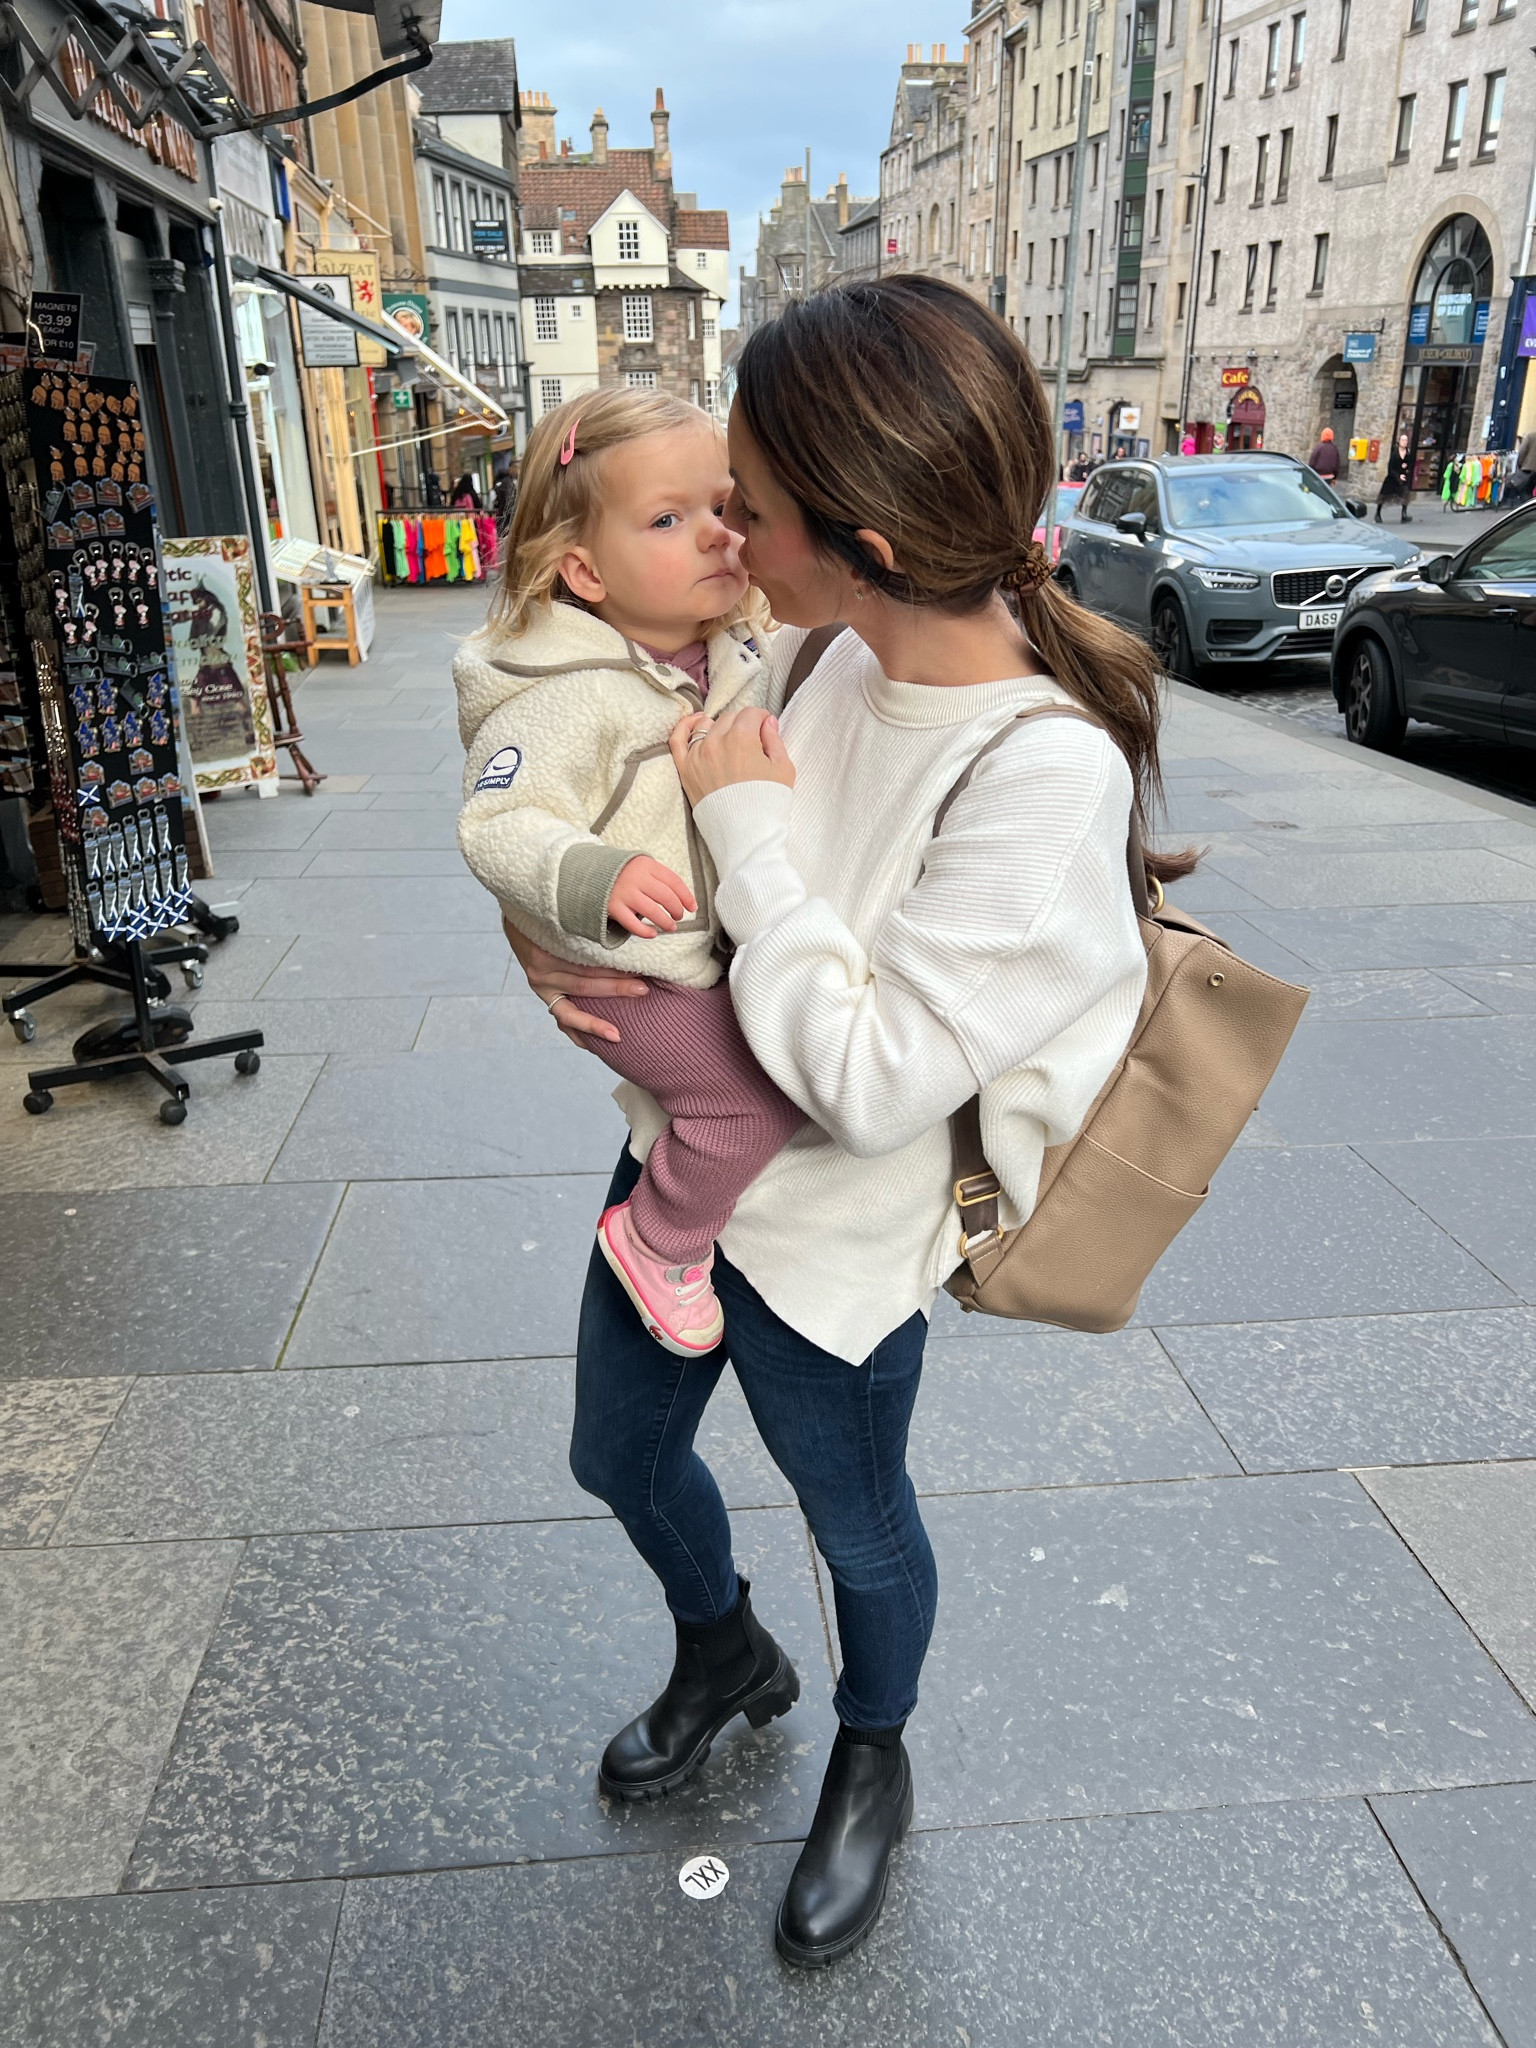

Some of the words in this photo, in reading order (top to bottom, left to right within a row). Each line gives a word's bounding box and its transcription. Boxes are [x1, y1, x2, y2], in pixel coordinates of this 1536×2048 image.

[34, 302, 78, 312] MAGNETS
[37, 313, 72, 327] £3.99
[43, 326, 65, 334] EACH
[31, 338, 37, 346] 3
[44, 338, 57, 347] OR
[58, 340, 74, 349] £10
[1306, 613, 1338, 627] DA69
[684, 1859, 726, 1891] XXL
